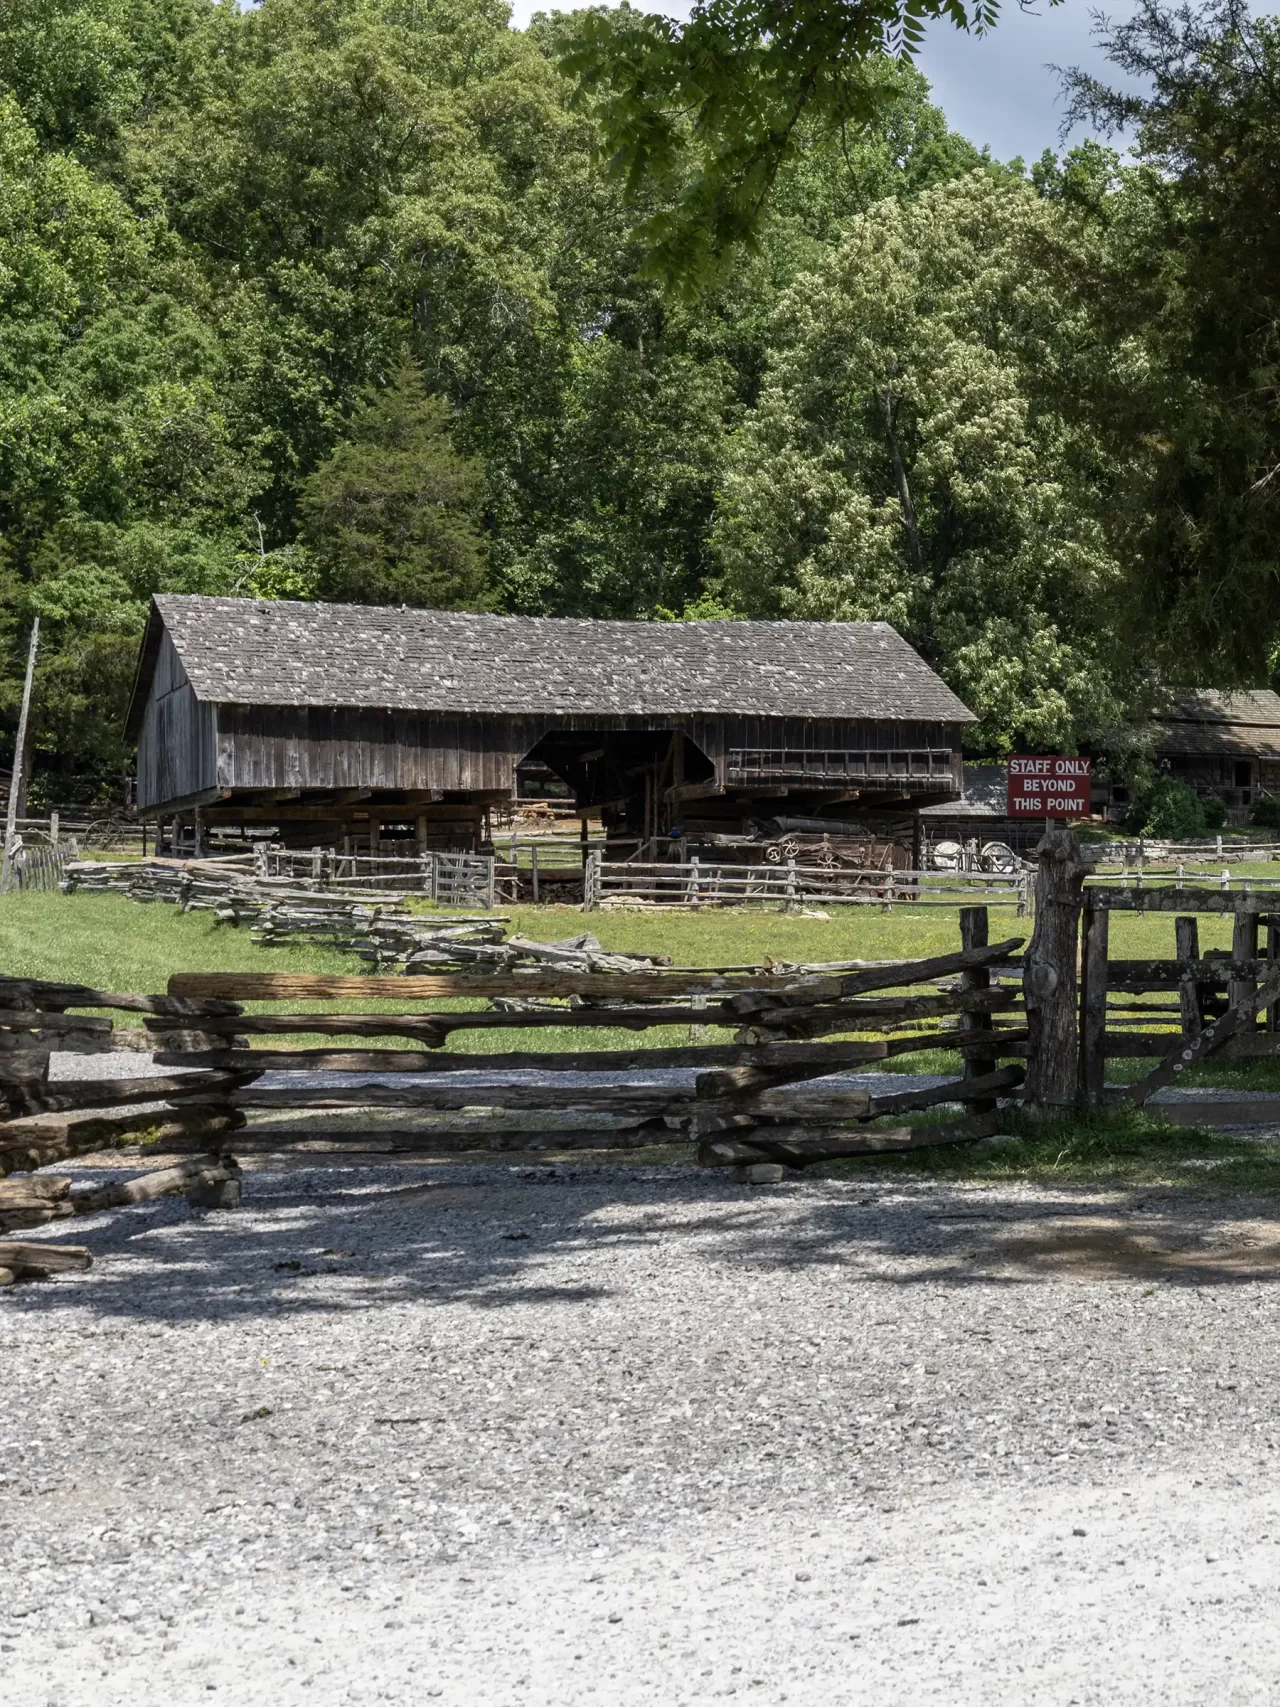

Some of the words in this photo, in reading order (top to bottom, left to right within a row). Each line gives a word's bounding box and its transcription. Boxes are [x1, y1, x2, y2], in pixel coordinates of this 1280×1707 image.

[1010, 759, 1051, 773] STAFF
[1055, 760, 1090, 774] ONLY
[1023, 779, 1076, 792] BEYOND
[1013, 797, 1042, 810] THIS
[1047, 798, 1085, 811] POINT
